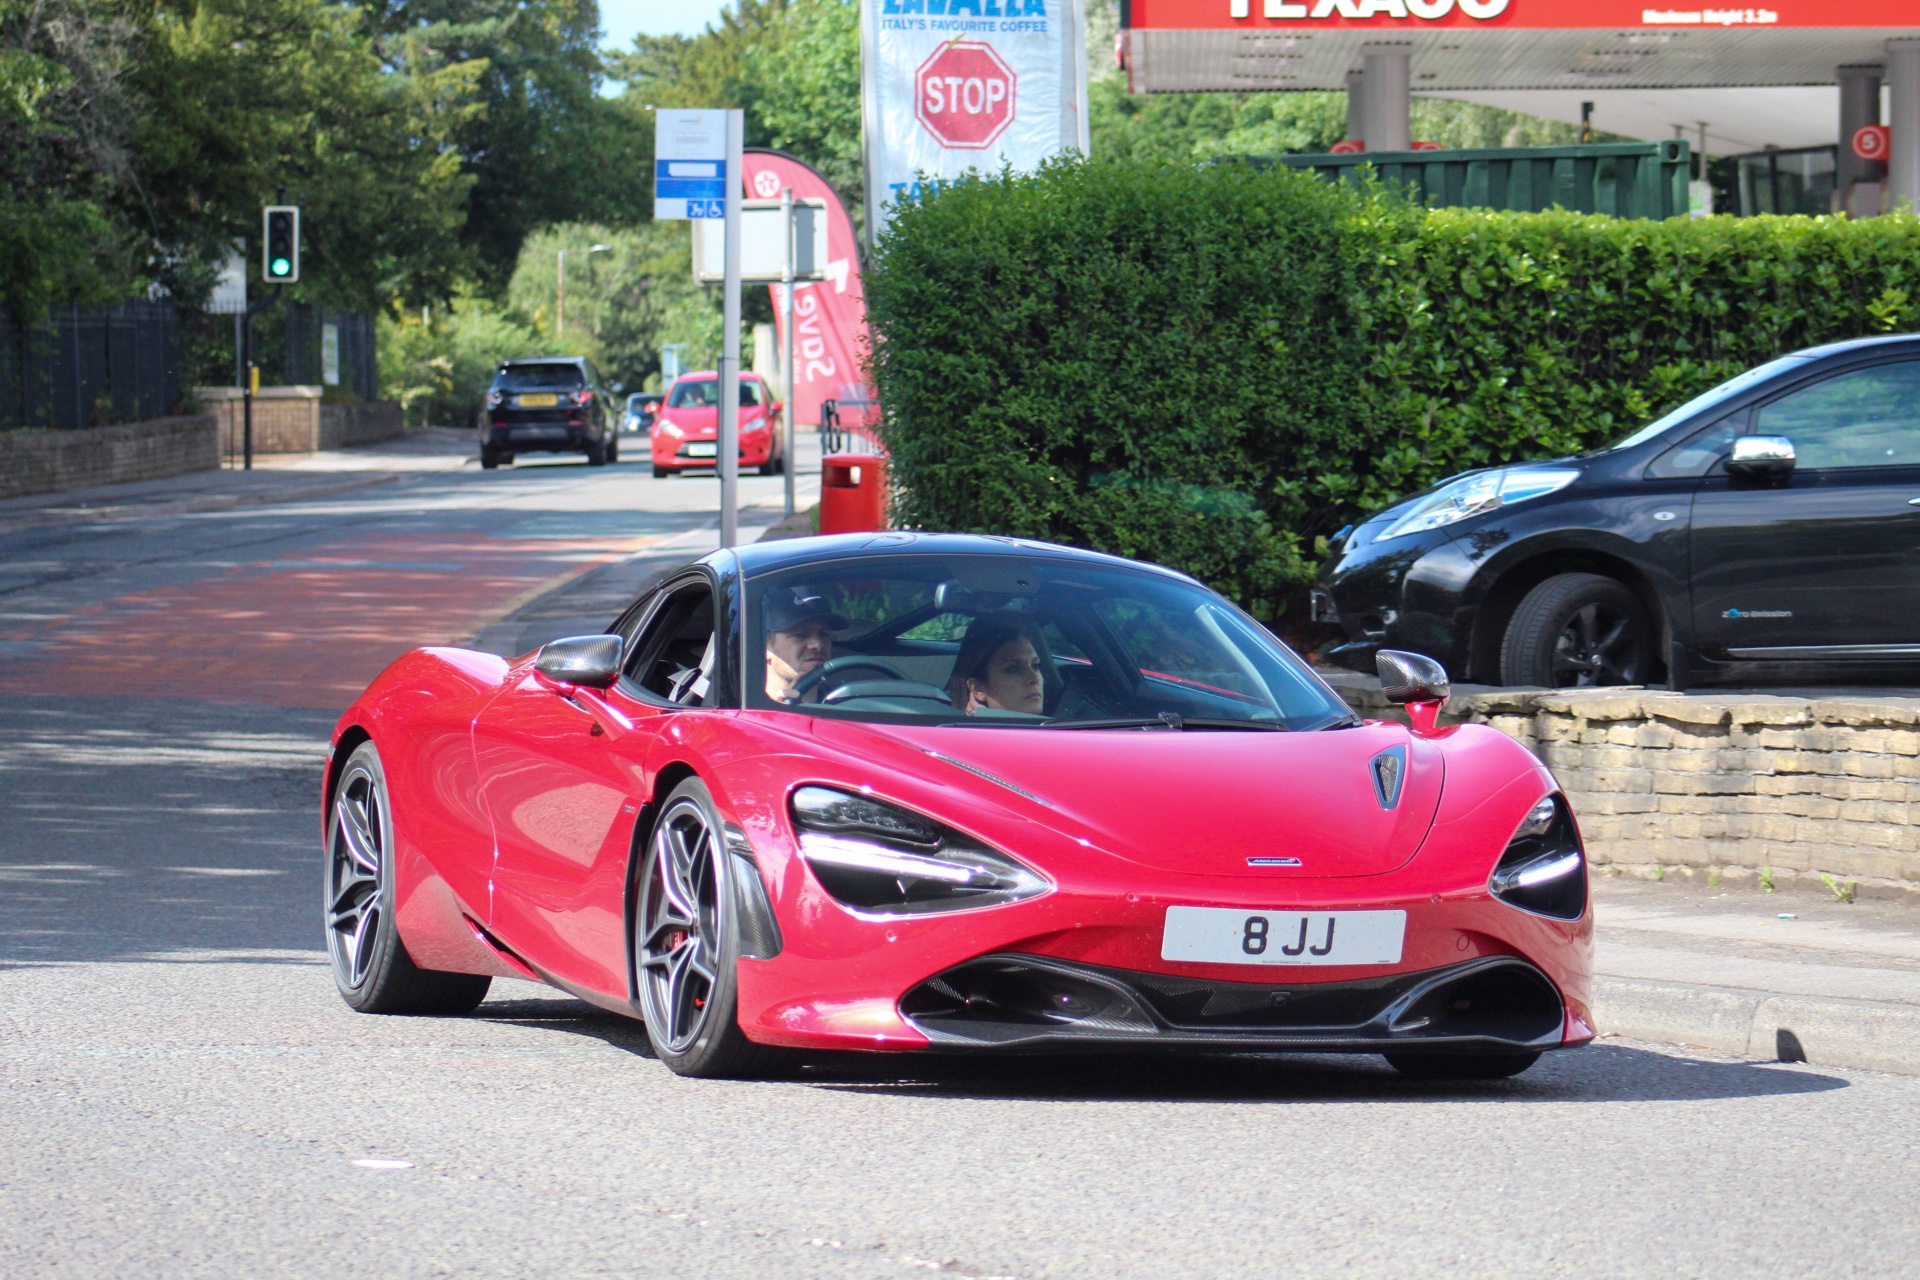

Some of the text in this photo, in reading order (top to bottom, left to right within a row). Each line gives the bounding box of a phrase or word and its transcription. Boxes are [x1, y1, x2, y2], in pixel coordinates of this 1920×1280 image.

[882, 19, 1048, 32] ITALY'S FAVOURITE COFFEE
[925, 76, 1006, 115] STOP
[1242, 916, 1336, 956] 8 JJ
